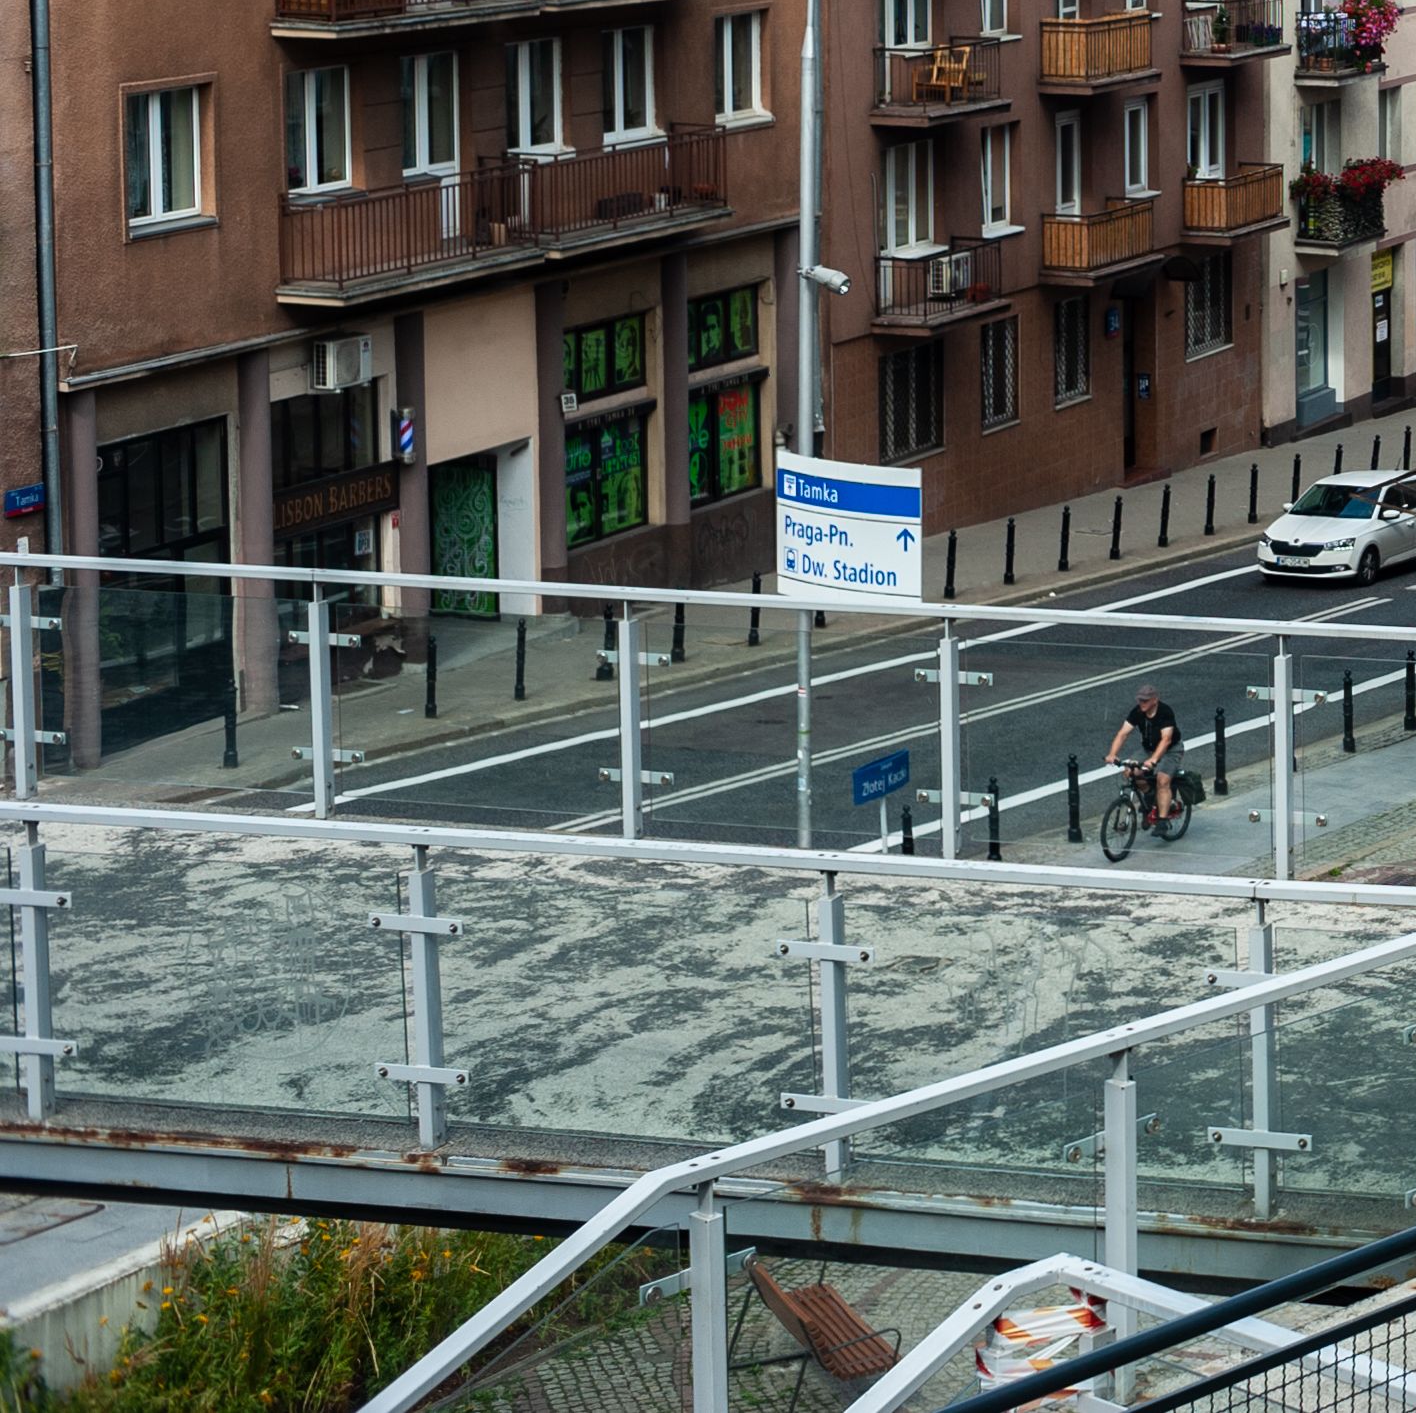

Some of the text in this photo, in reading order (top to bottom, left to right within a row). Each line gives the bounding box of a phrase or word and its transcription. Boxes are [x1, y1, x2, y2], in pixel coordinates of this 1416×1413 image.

[273, 473, 392, 530] LISBON BARBERS
[798, 479, 838, 503] Tamka
[784, 515, 854, 547] Praga-Pn.
[802, 554, 897, 587] Dw. Stadion
